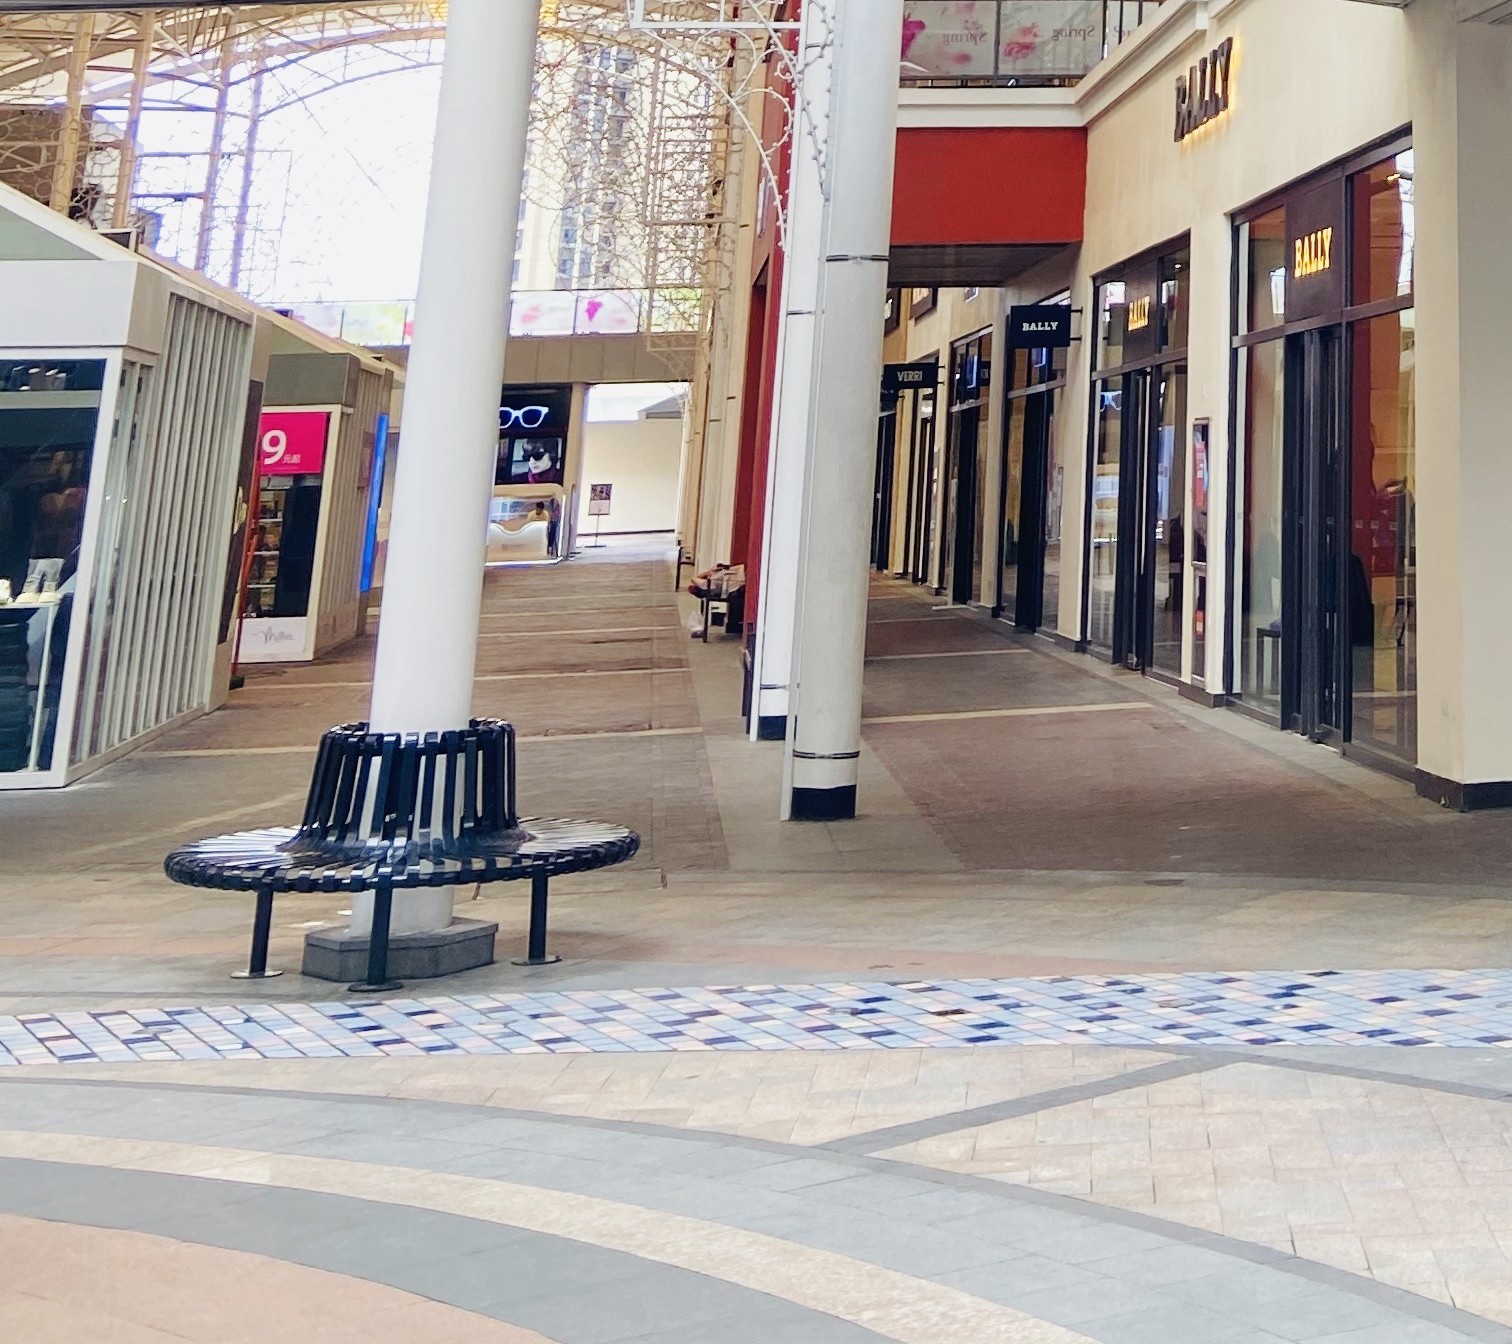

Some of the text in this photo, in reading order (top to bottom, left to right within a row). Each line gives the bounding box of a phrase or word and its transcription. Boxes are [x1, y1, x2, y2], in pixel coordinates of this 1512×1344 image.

[1174, 36, 1234, 143] BALLY
[1293, 226, 1334, 278] BALLY
[1022, 321, 1059, 332] BALLY
